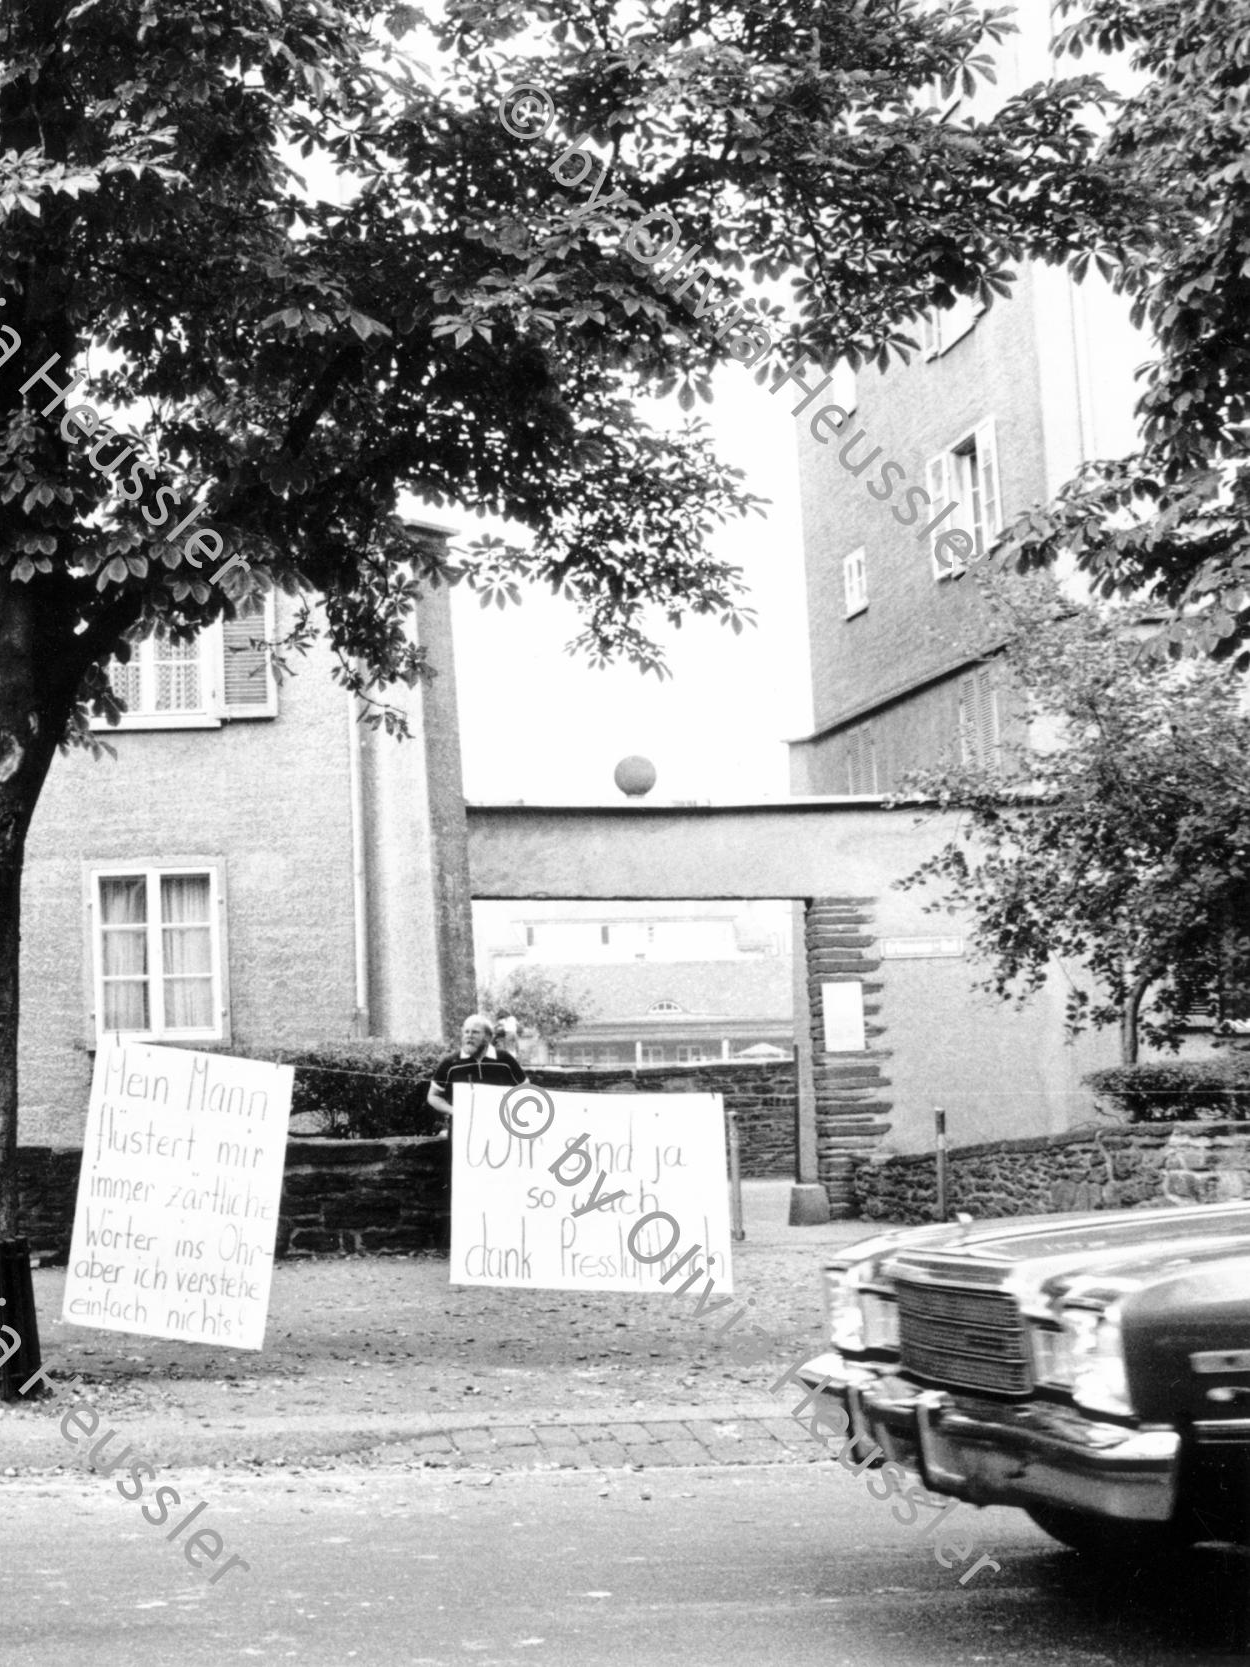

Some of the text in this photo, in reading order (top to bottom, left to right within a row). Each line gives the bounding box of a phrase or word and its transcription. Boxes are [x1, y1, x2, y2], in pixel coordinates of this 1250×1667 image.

[104, 1047, 269, 1121] Mein Mann
[96, 1102, 265, 1169] flüstert mir
[465, 1091, 688, 1184] Wir sind ja
[90, 1164, 274, 1221] immer zärtliche
[525, 1179, 660, 1215] so wach
[85, 1206, 159, 1252] Wörter
[174, 1218, 206, 1260] ins
[464, 1211, 533, 1280] dank
[73, 1250, 264, 1301] aber ich verstehe
[68, 1285, 148, 1325] einfach
